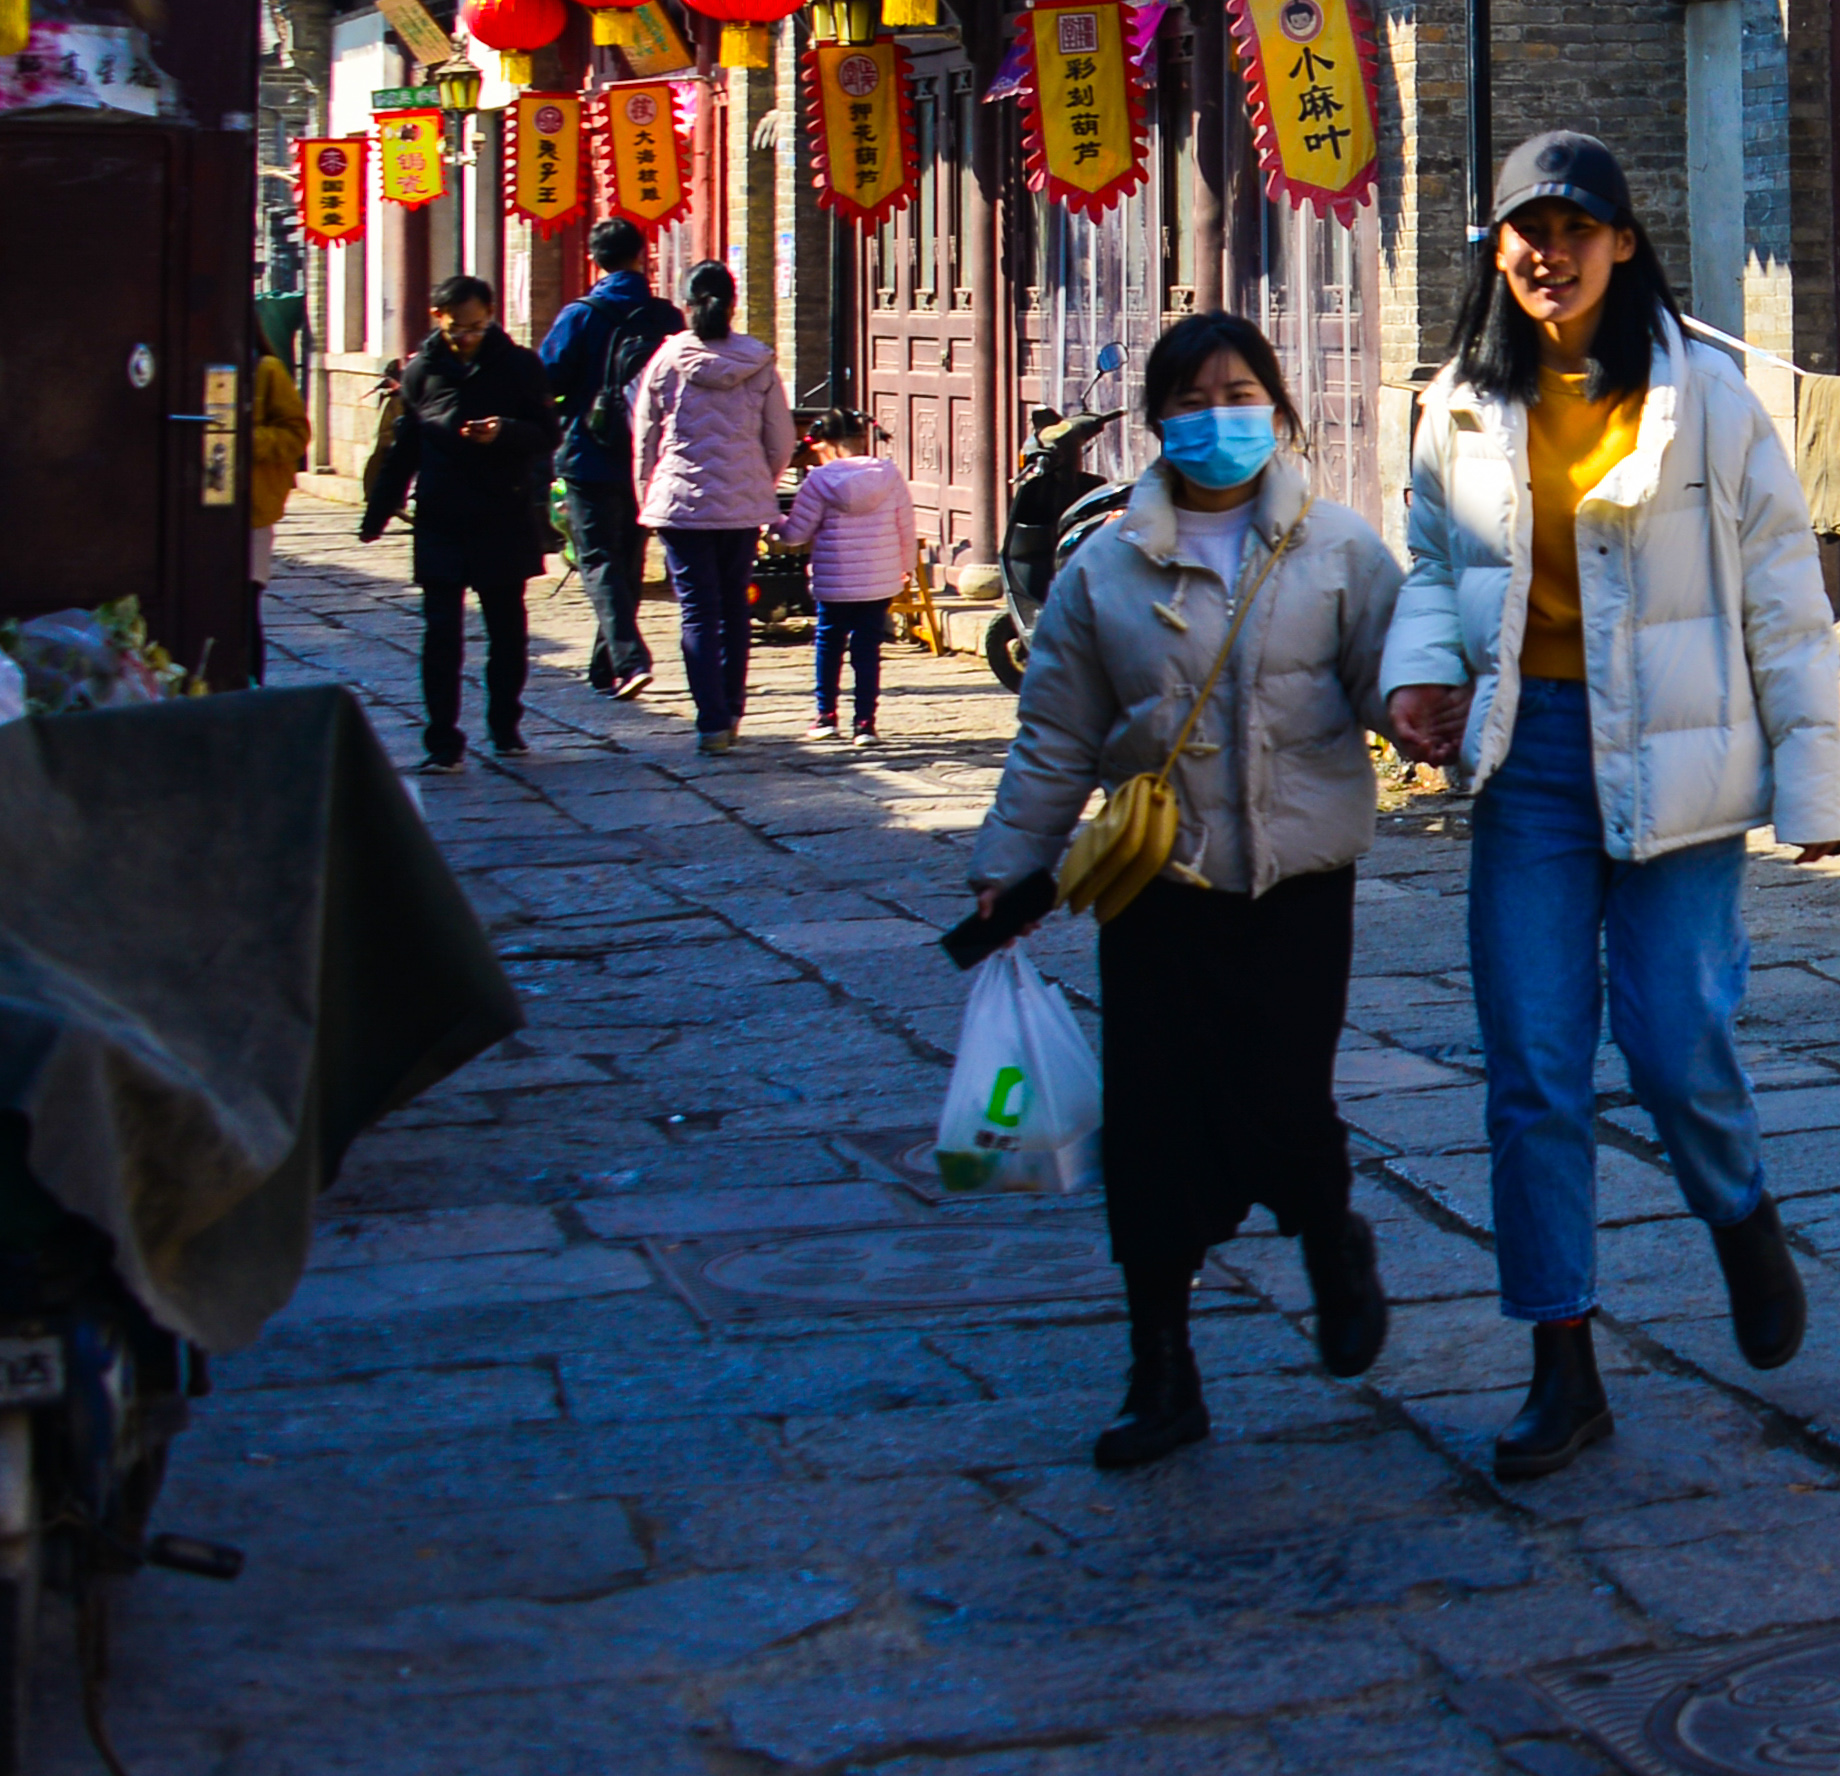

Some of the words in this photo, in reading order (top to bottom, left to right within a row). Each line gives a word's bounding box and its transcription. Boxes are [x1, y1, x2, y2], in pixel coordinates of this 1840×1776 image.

[1064, 57, 1102, 165] 彩刻葫芦
[1288, 46, 1351, 159] 小麻叶
